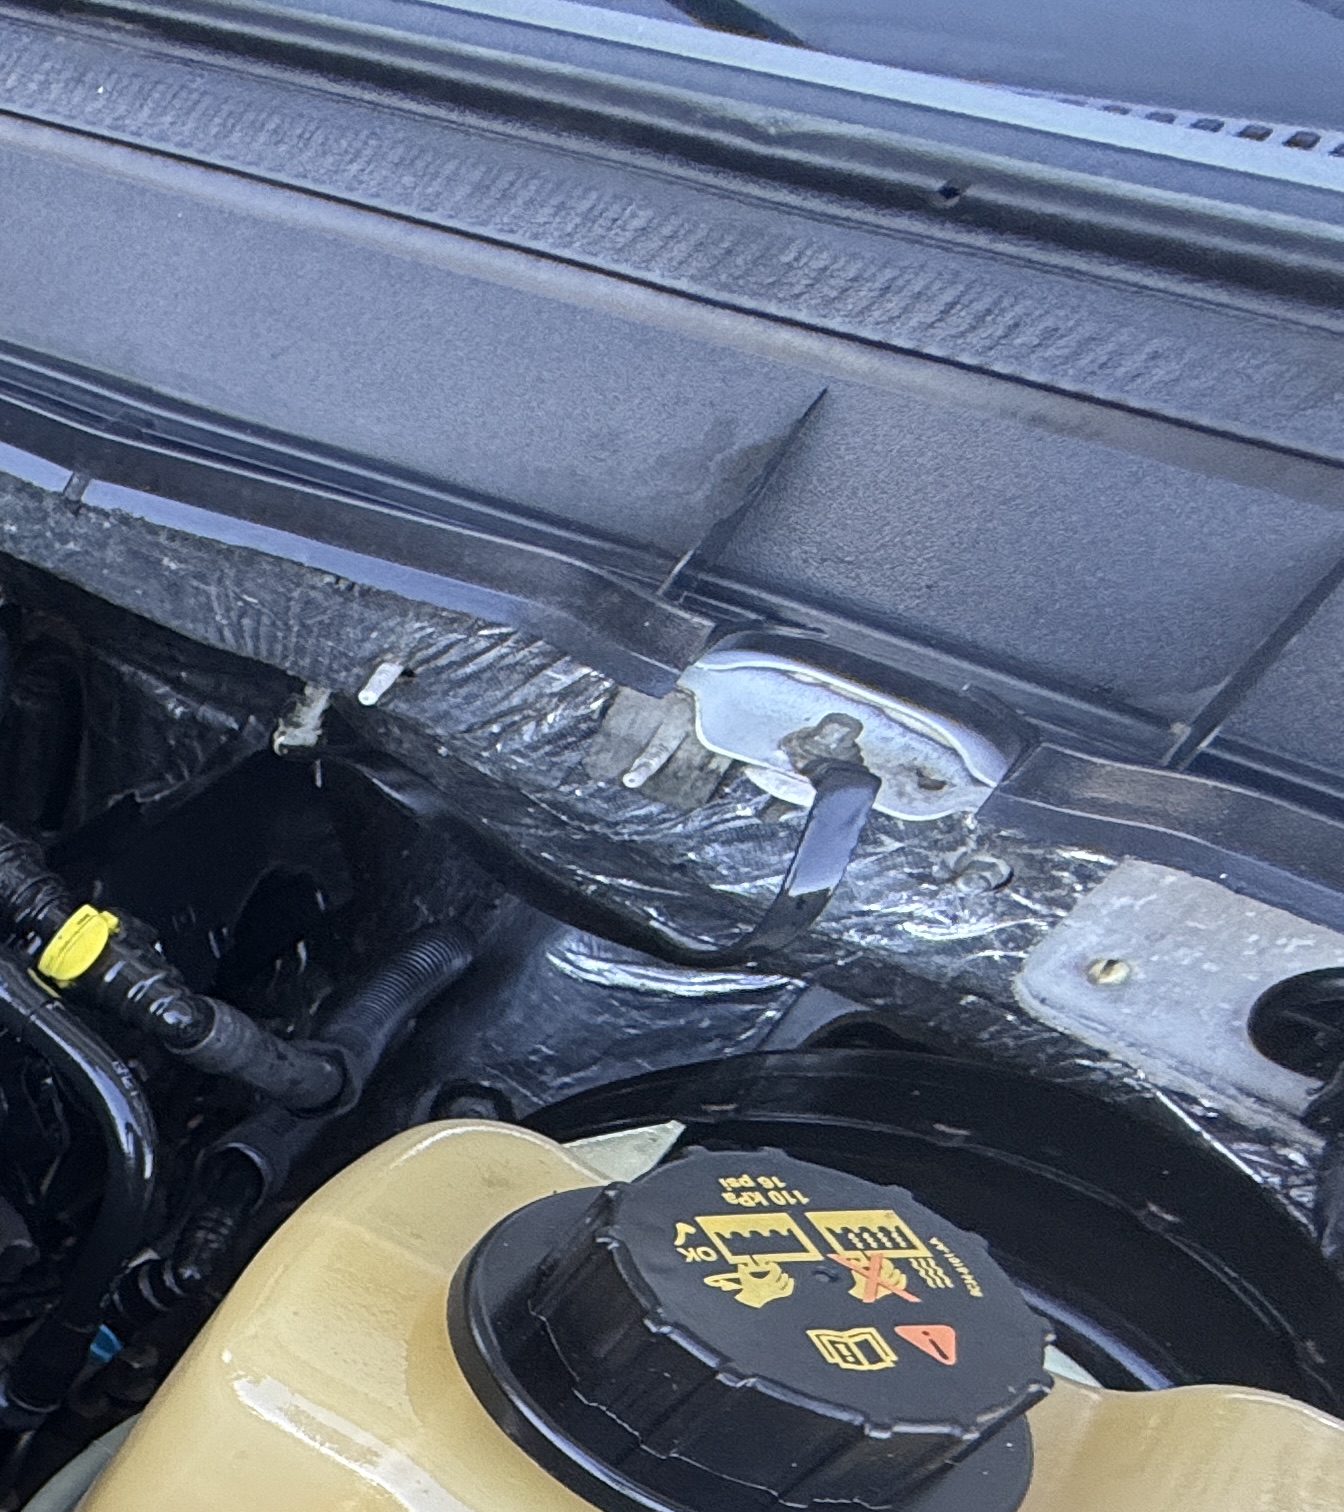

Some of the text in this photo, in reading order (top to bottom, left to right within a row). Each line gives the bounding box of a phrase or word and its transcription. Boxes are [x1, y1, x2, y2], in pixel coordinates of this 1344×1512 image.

[717, 1172, 786, 1190] 16 psi
[720, 1188, 810, 1207] 110 kPa
[674, 1244, 716, 1263] OK
